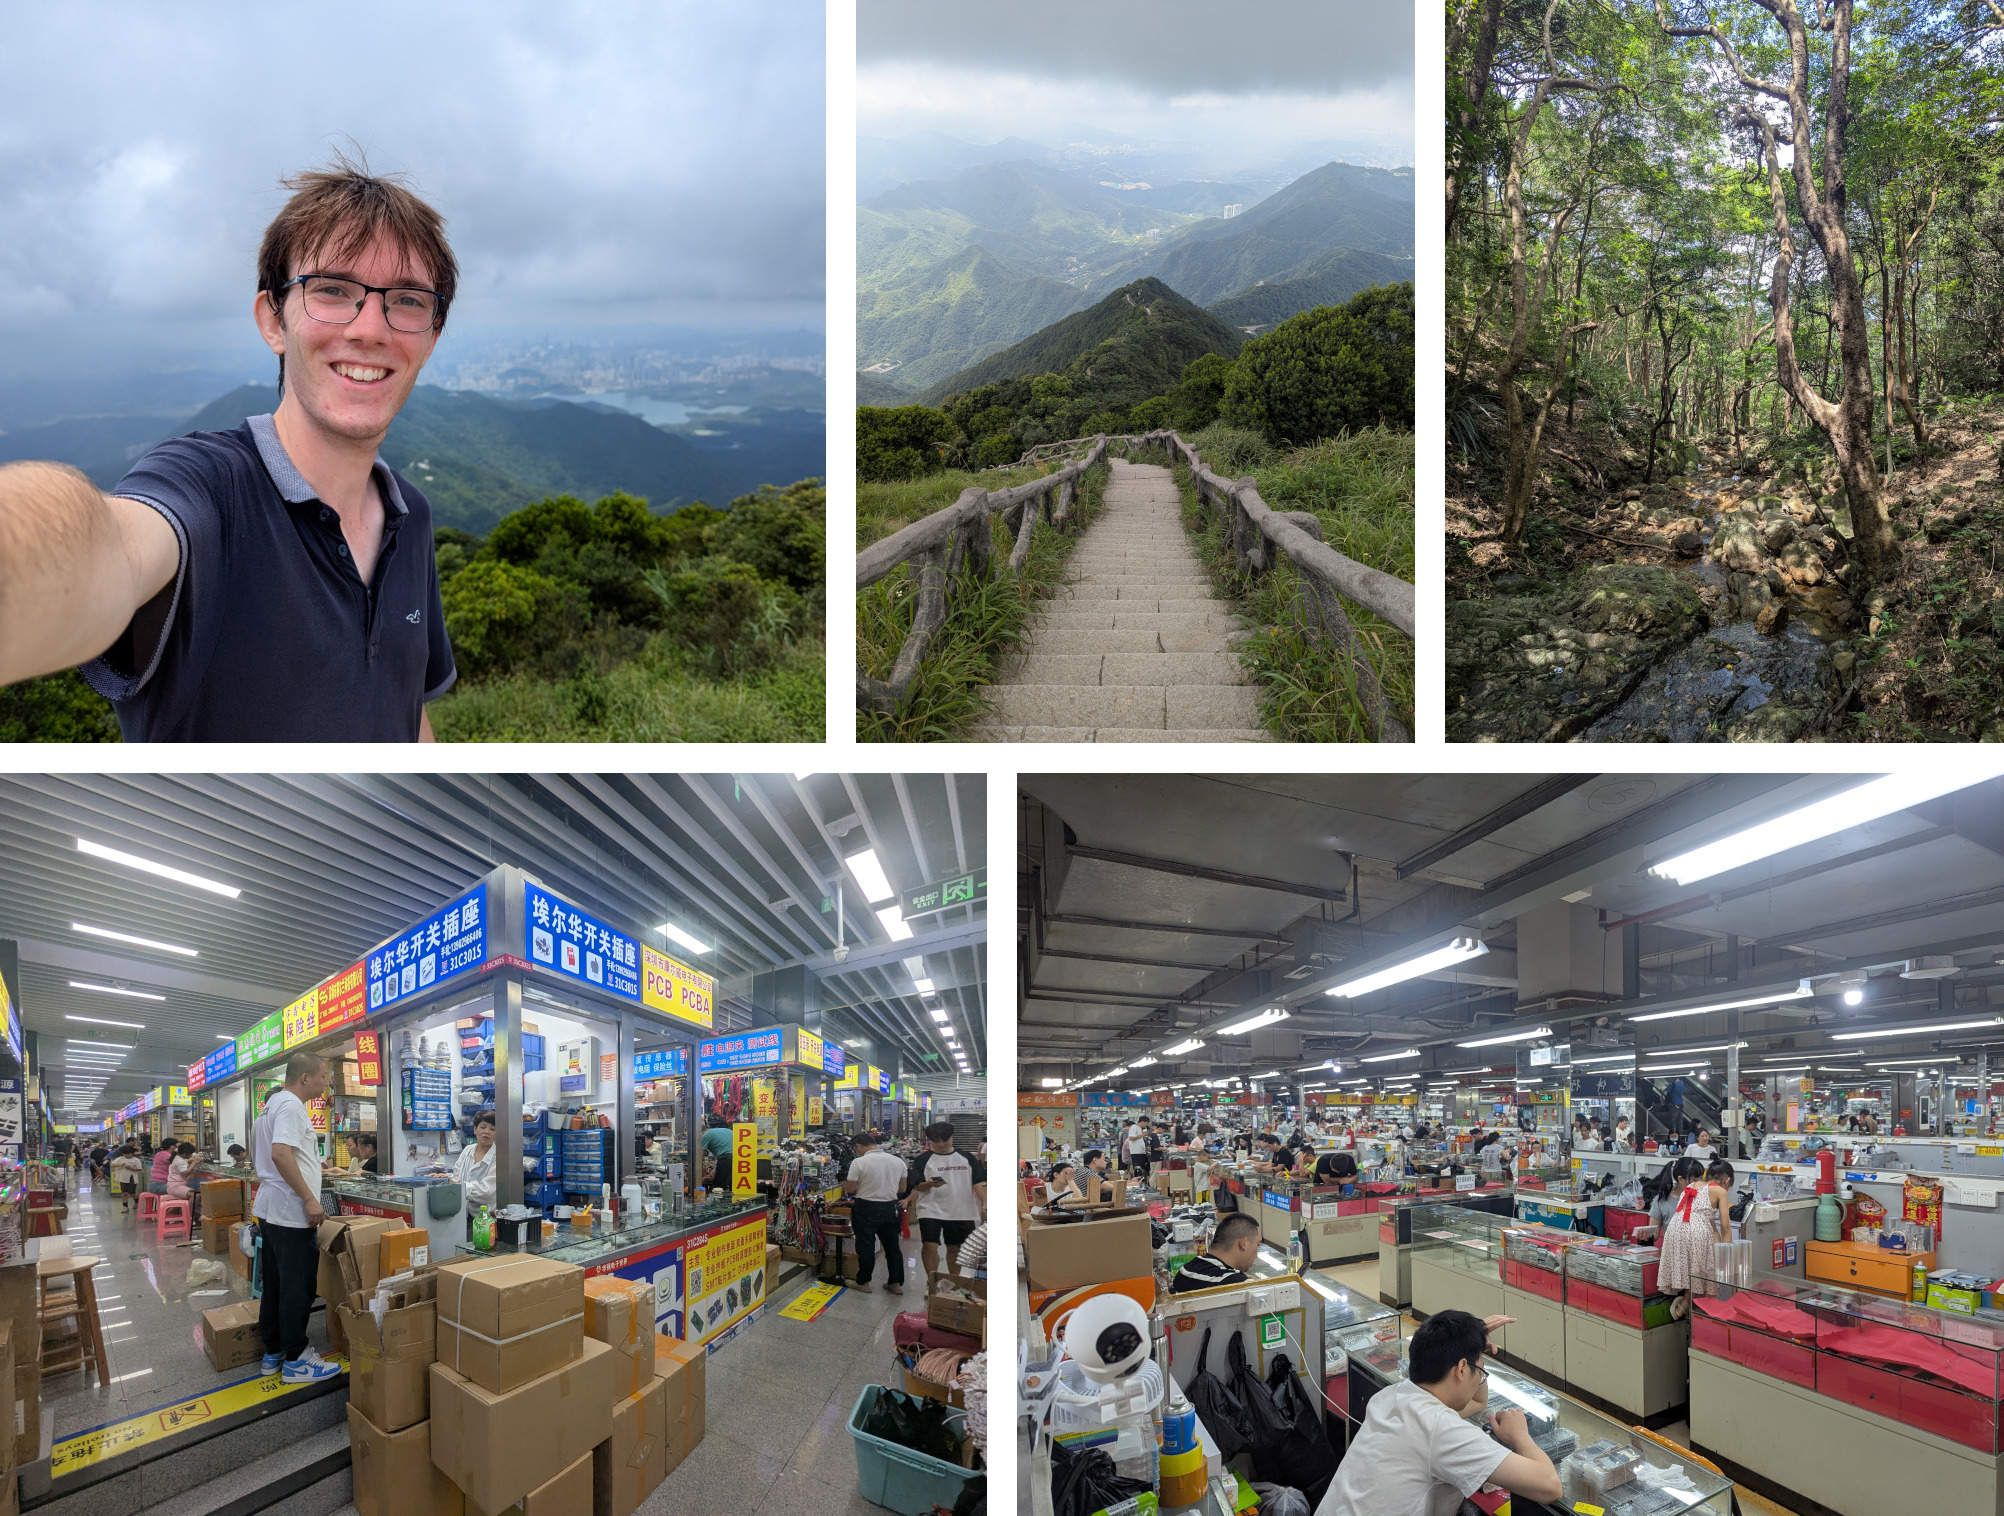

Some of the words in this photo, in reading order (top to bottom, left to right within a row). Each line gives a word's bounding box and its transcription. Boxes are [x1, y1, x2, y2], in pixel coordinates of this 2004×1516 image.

[912, 891, 939, 905] 安全出口
[917, 900, 935, 908] EXIT
[370, 898, 480, 979] 埃尔华开关插座
[533, 894, 636, 968] 埃尔华开关插座
[449, 944, 482, 971] 31C301S
[615, 977, 638, 995] 31C301S
[648, 970, 673, 999] PCB
[681, 986, 711, 1016] PCBA
[286, 1011, 316, 1040] 保险丝
[716, 1040, 744, 1054] 电源夹
[747, 1034, 778, 1049] 测试线
[359, 1036, 379, 1080] 线圈
[653, 1061, 672, 1073] 保险丝
[311, 1096, 327, 1129] 险丝
[811, 1098, 821, 1124] 变压器
[736, 1129, 752, 1190] PCBA
[687, 1233, 708, 1249] 31C284S
[602, 1257, 627, 1272] 华强电子世界
[57, 1433, 110, 1453] trolleys
[114, 1426, 132, 1434] No
[52, 1428, 145, 1467] 禁止拖车
